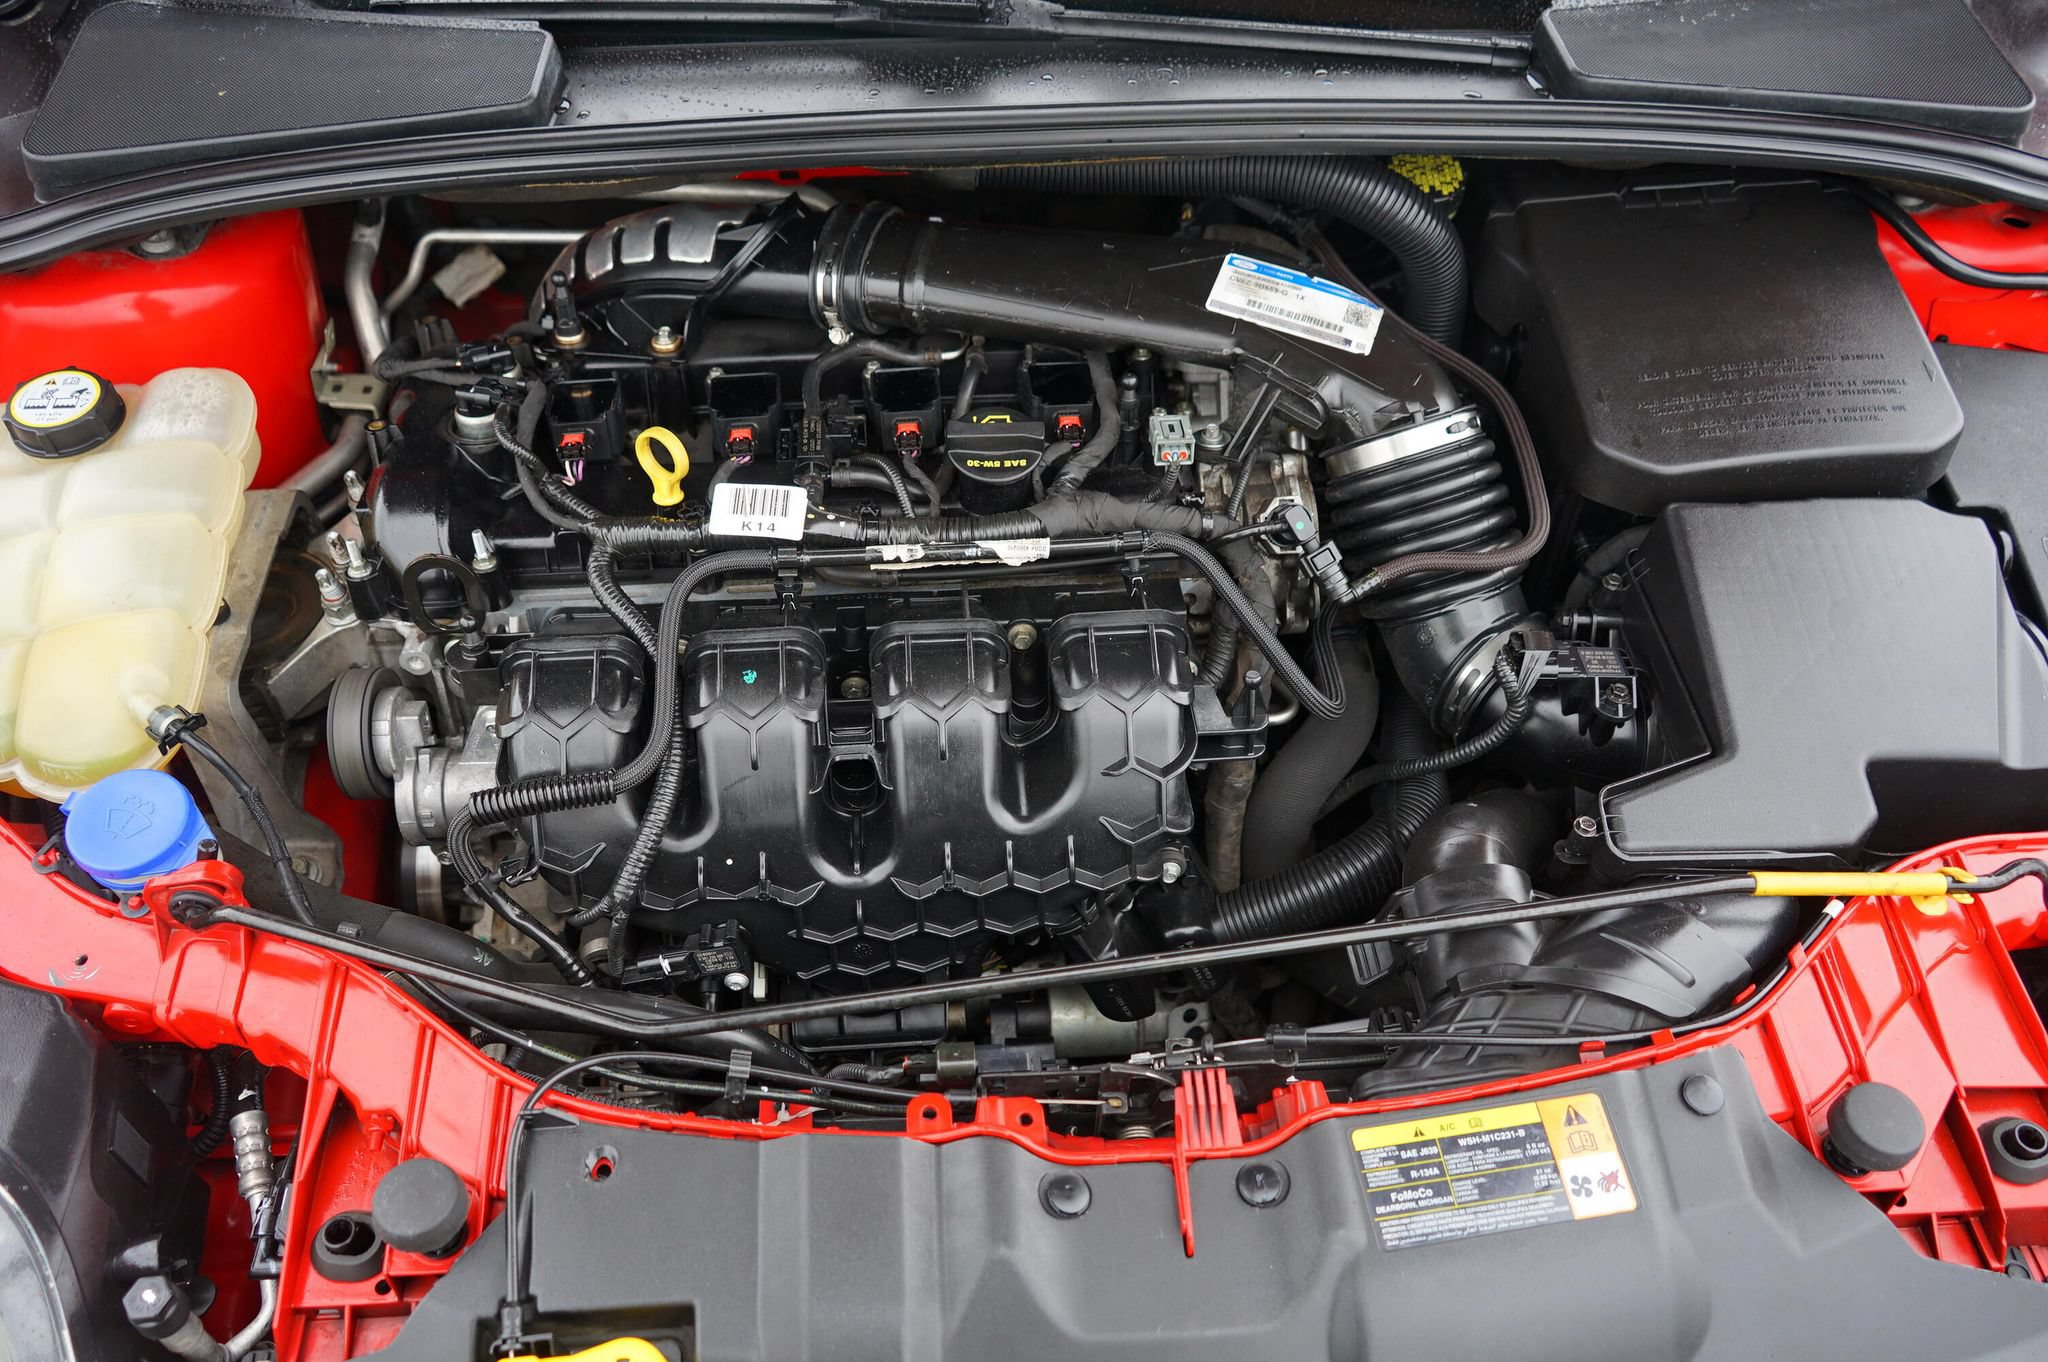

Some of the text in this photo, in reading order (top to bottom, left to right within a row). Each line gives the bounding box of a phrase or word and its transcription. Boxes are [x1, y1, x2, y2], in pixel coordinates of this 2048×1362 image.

[966, 459, 1027, 468] SAE 5W-30
[1439, 1123, 1456, 1132] A/C
[1457, 1129, 1527, 1147] WSH-M1C231-B
[1400, 1149, 1419, 1159] SAE
[1410, 1167, 1440, 1179] R-134A
[1390, 1186, 1435, 1203] FoMoCo
[1375, 1195, 1454, 1214] DEARBORN, MICHIGAN
